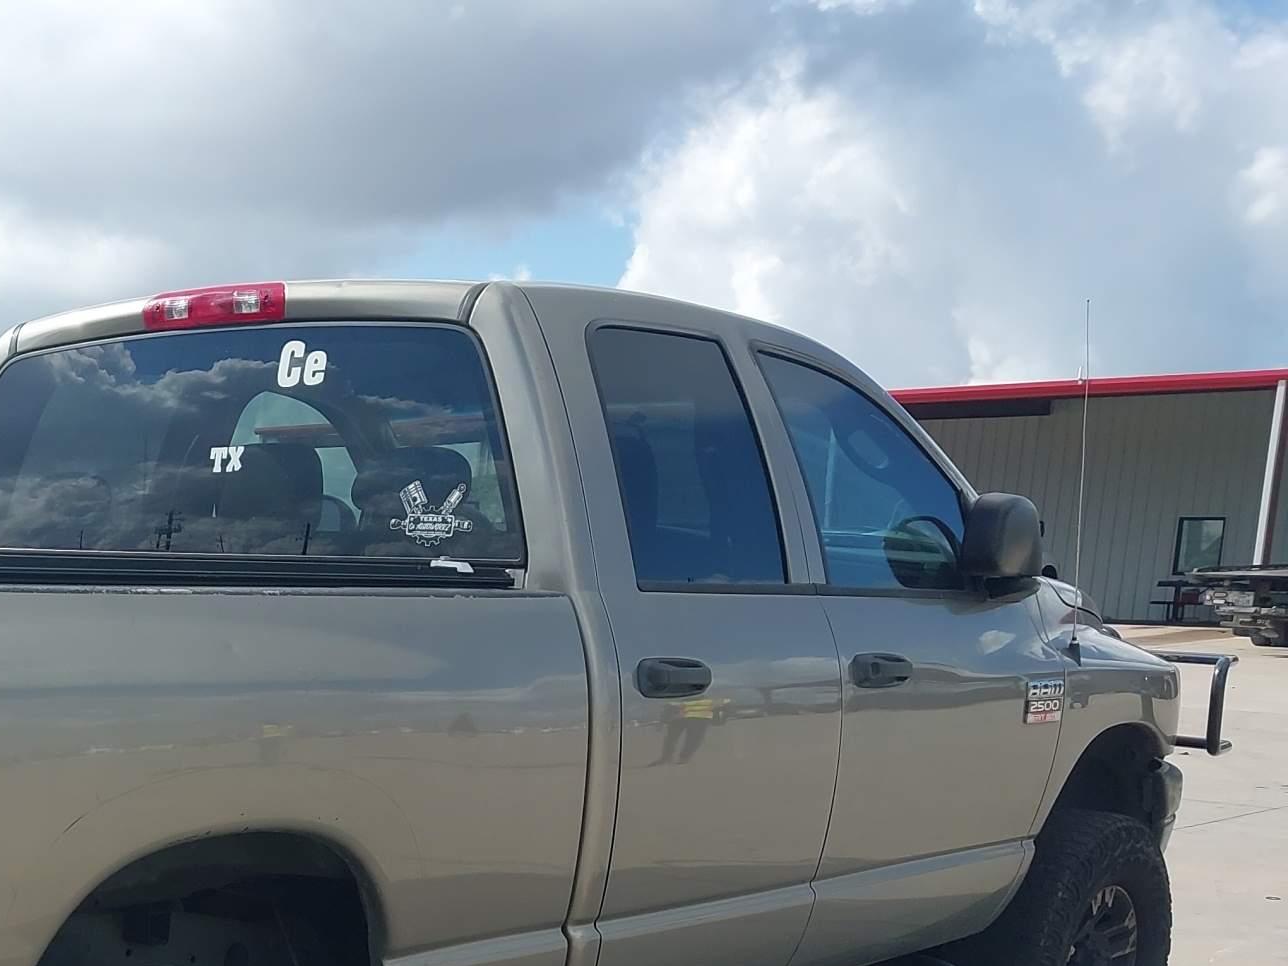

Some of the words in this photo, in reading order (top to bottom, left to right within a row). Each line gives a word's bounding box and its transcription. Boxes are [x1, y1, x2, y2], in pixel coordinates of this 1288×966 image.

[277, 340, 328, 388] Ce
[210, 445, 245, 473] TX
[1030, 700, 1059, 712] 2500
